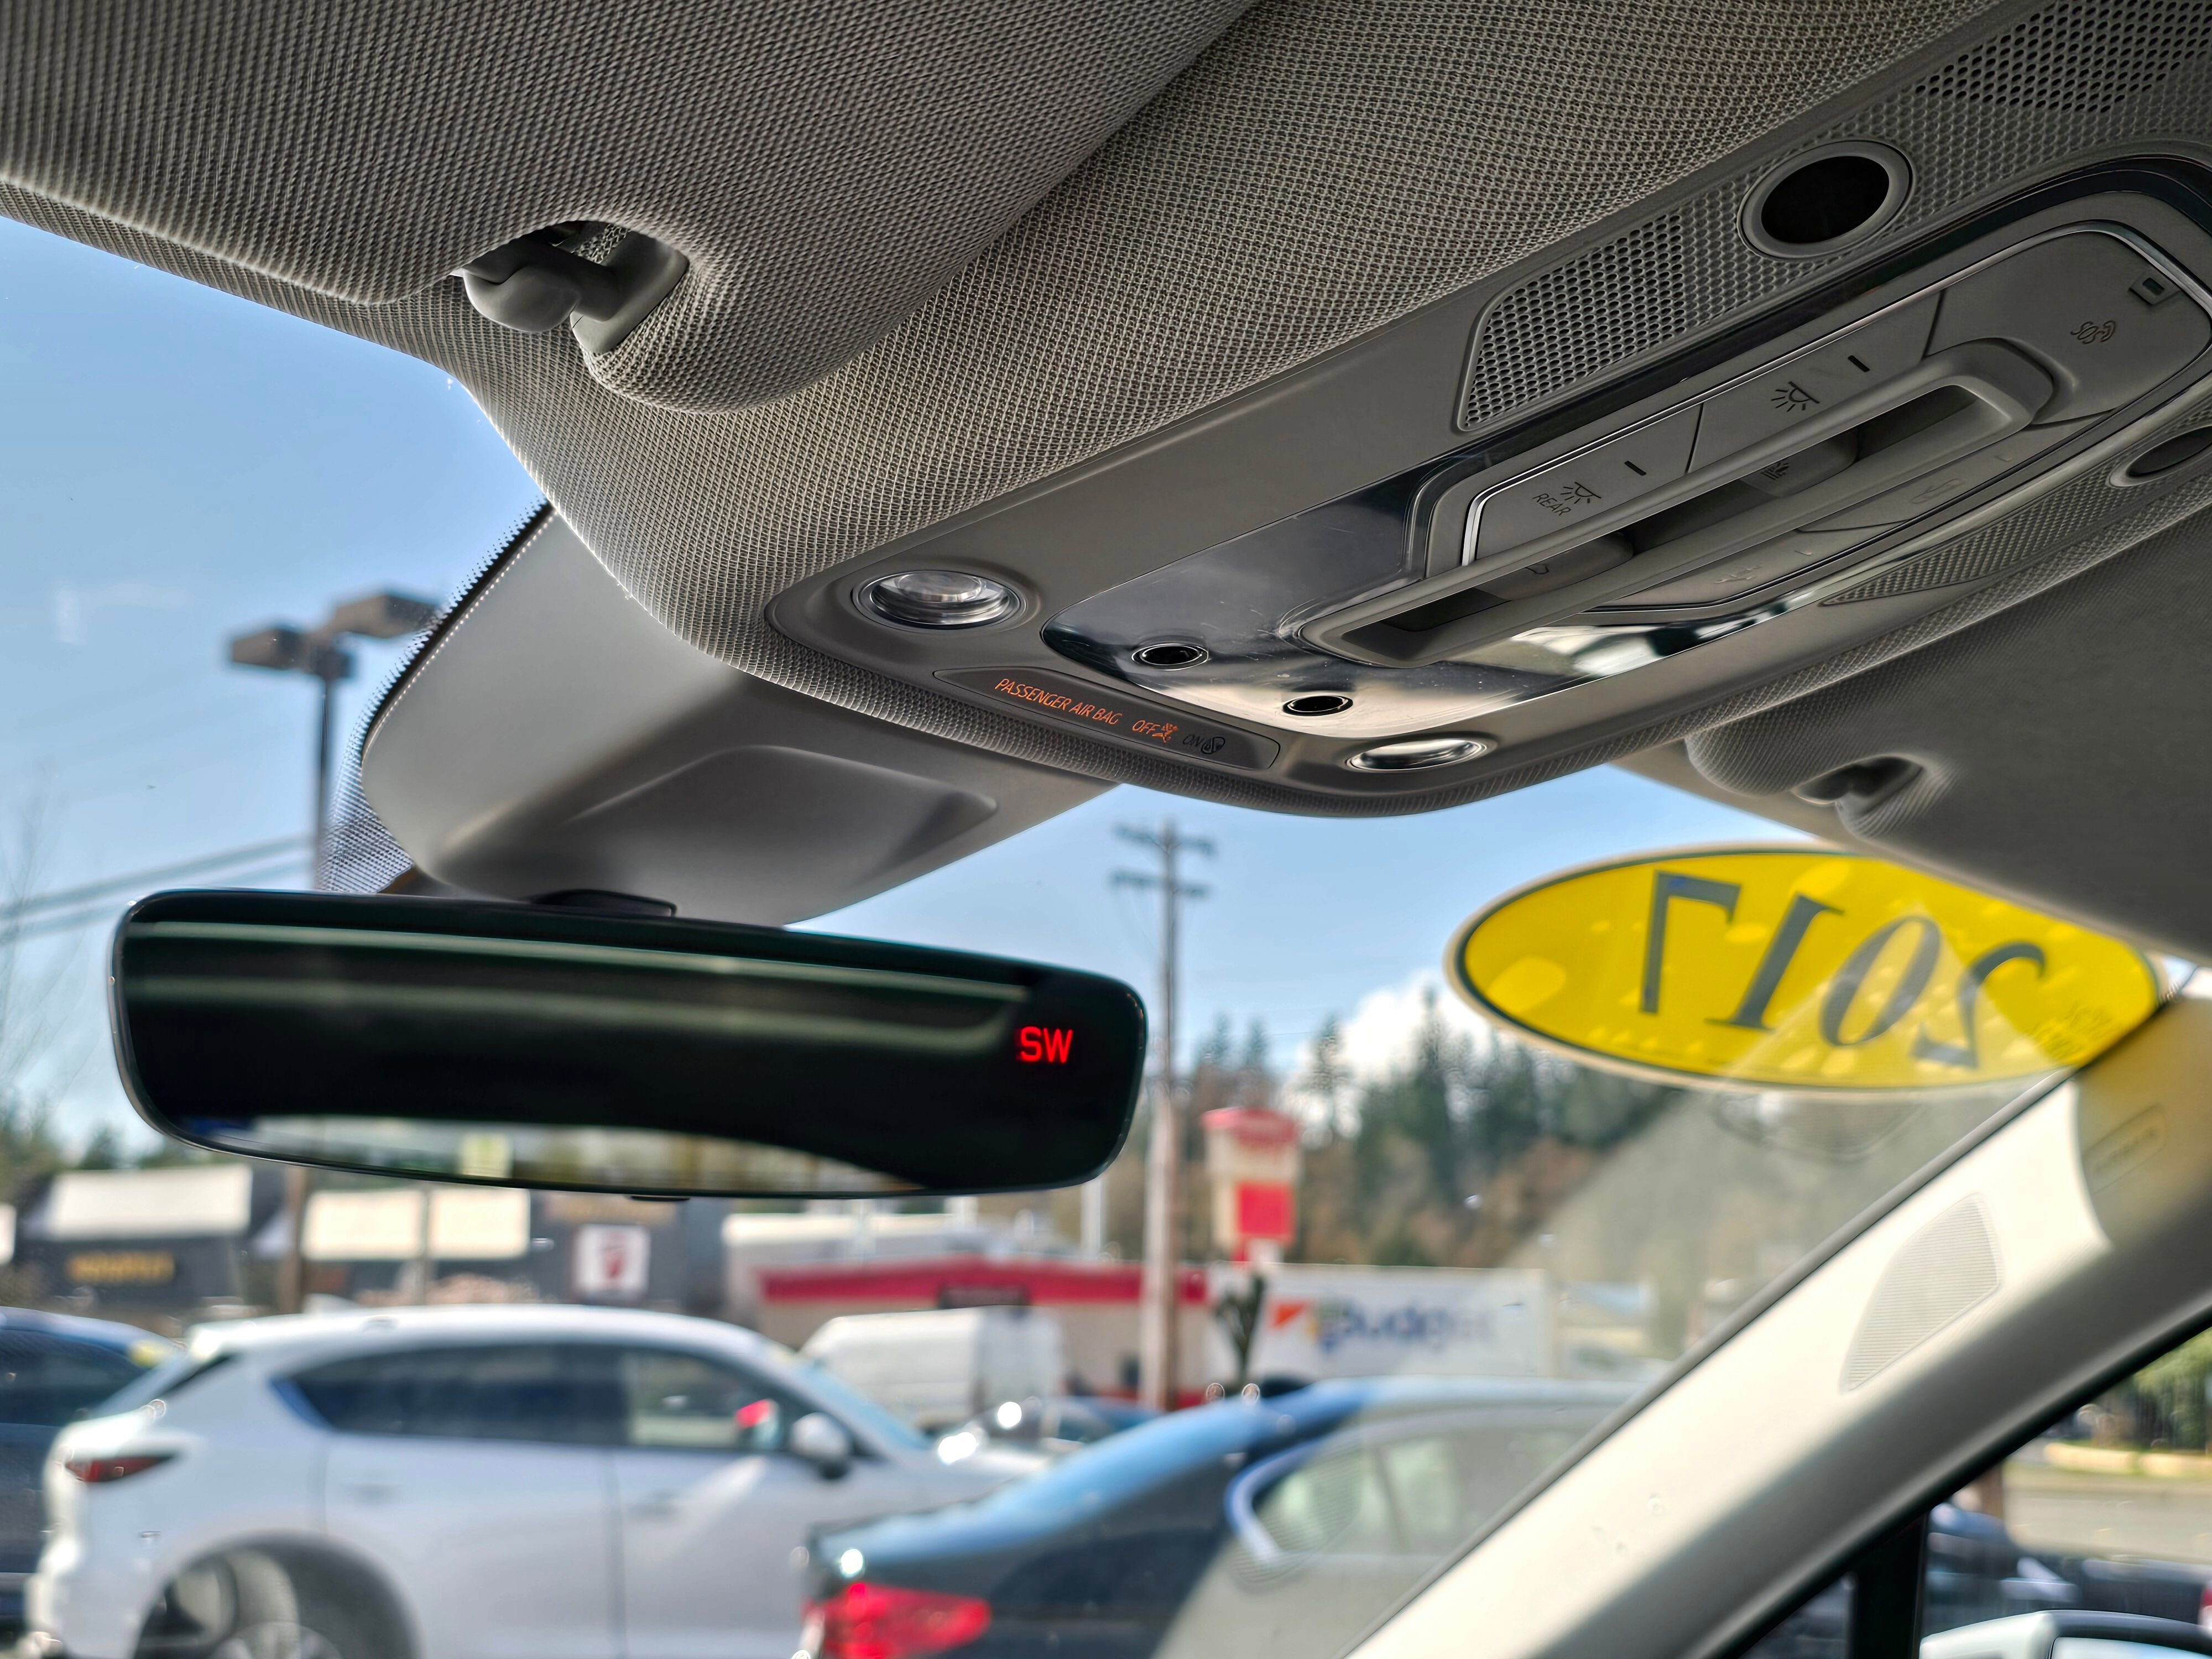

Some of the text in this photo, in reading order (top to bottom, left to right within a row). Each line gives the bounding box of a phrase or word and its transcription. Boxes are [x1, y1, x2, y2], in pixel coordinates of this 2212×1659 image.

[1532, 493, 1571, 516] REAR
[994, 678, 1204, 747] PASSENGER AIR BAG OFF ON
[1020, 1026, 1073, 1063] SW
